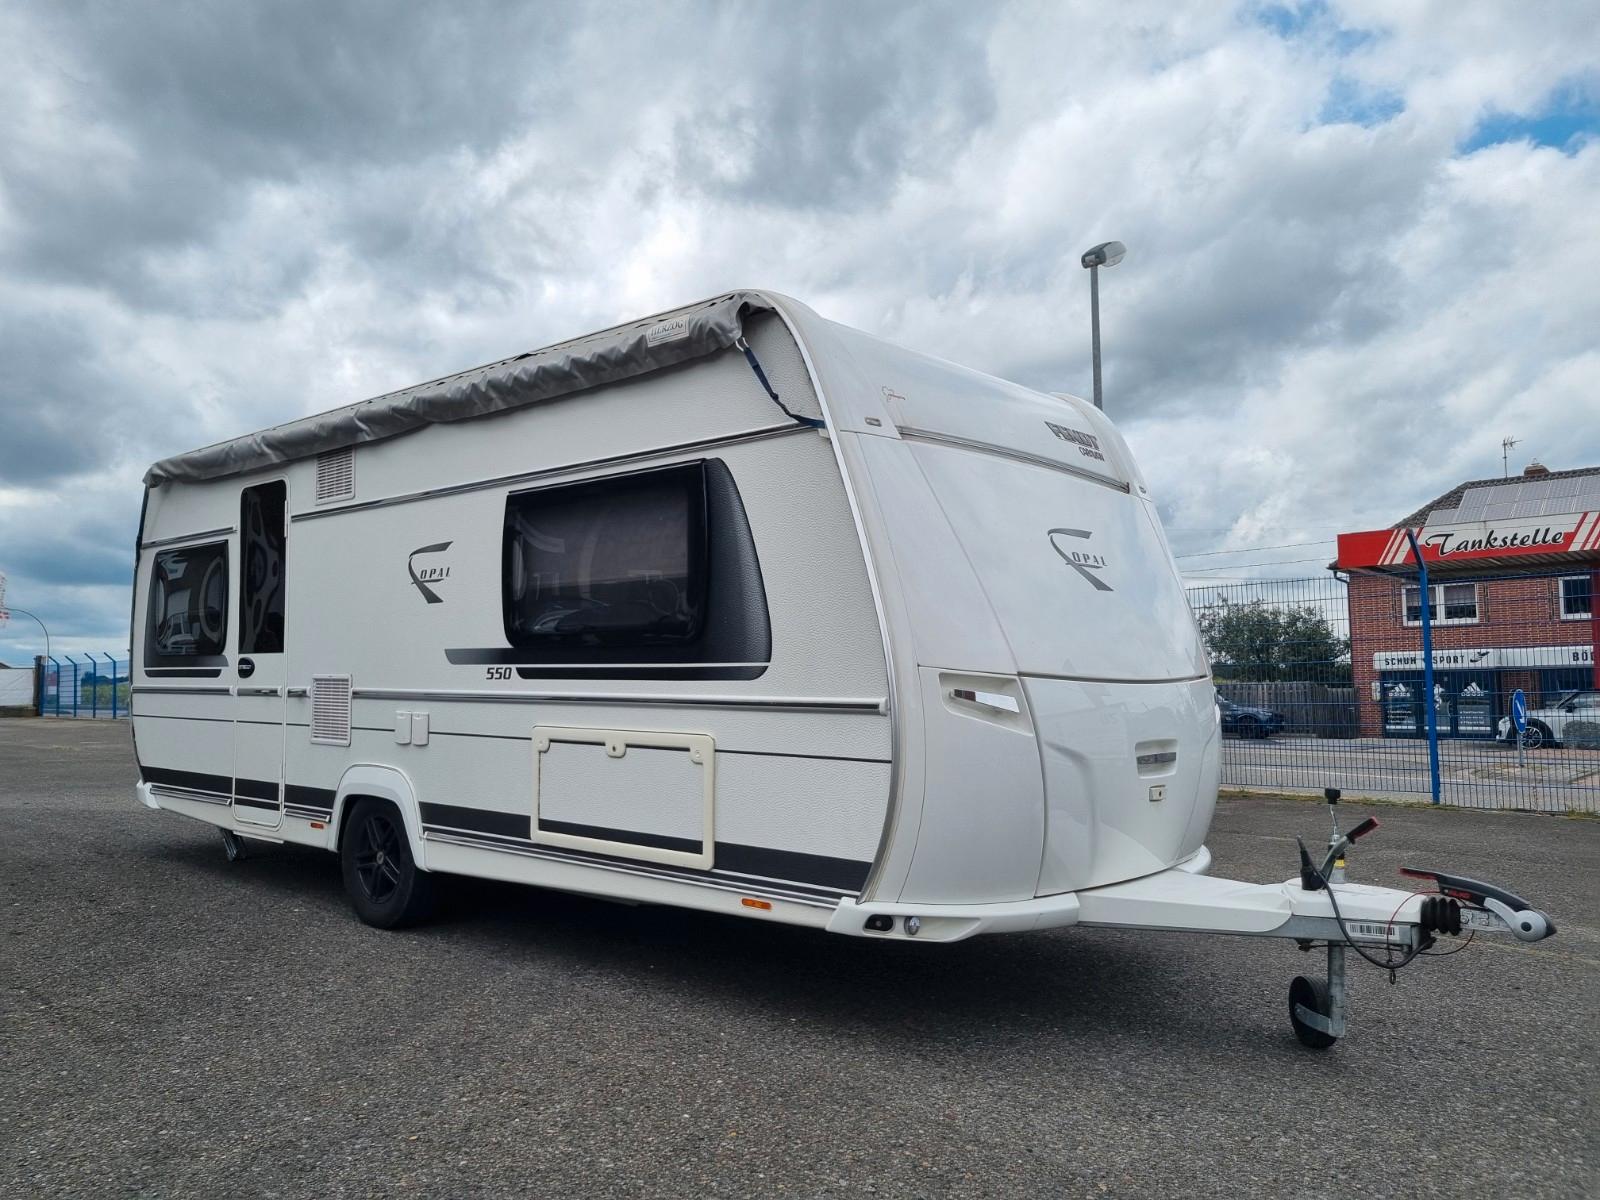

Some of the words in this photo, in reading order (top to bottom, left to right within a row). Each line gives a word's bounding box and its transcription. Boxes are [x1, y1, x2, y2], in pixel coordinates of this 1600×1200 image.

[1425, 527, 1564, 556] Tankstelle
[1071, 551, 1108, 567] OPAL
[420, 566, 451, 580] OPAL
[1384, 656, 1417, 666] SCHUH
[1432, 655, 1465, 665] SPORT
[485, 666, 513, 680] 550
